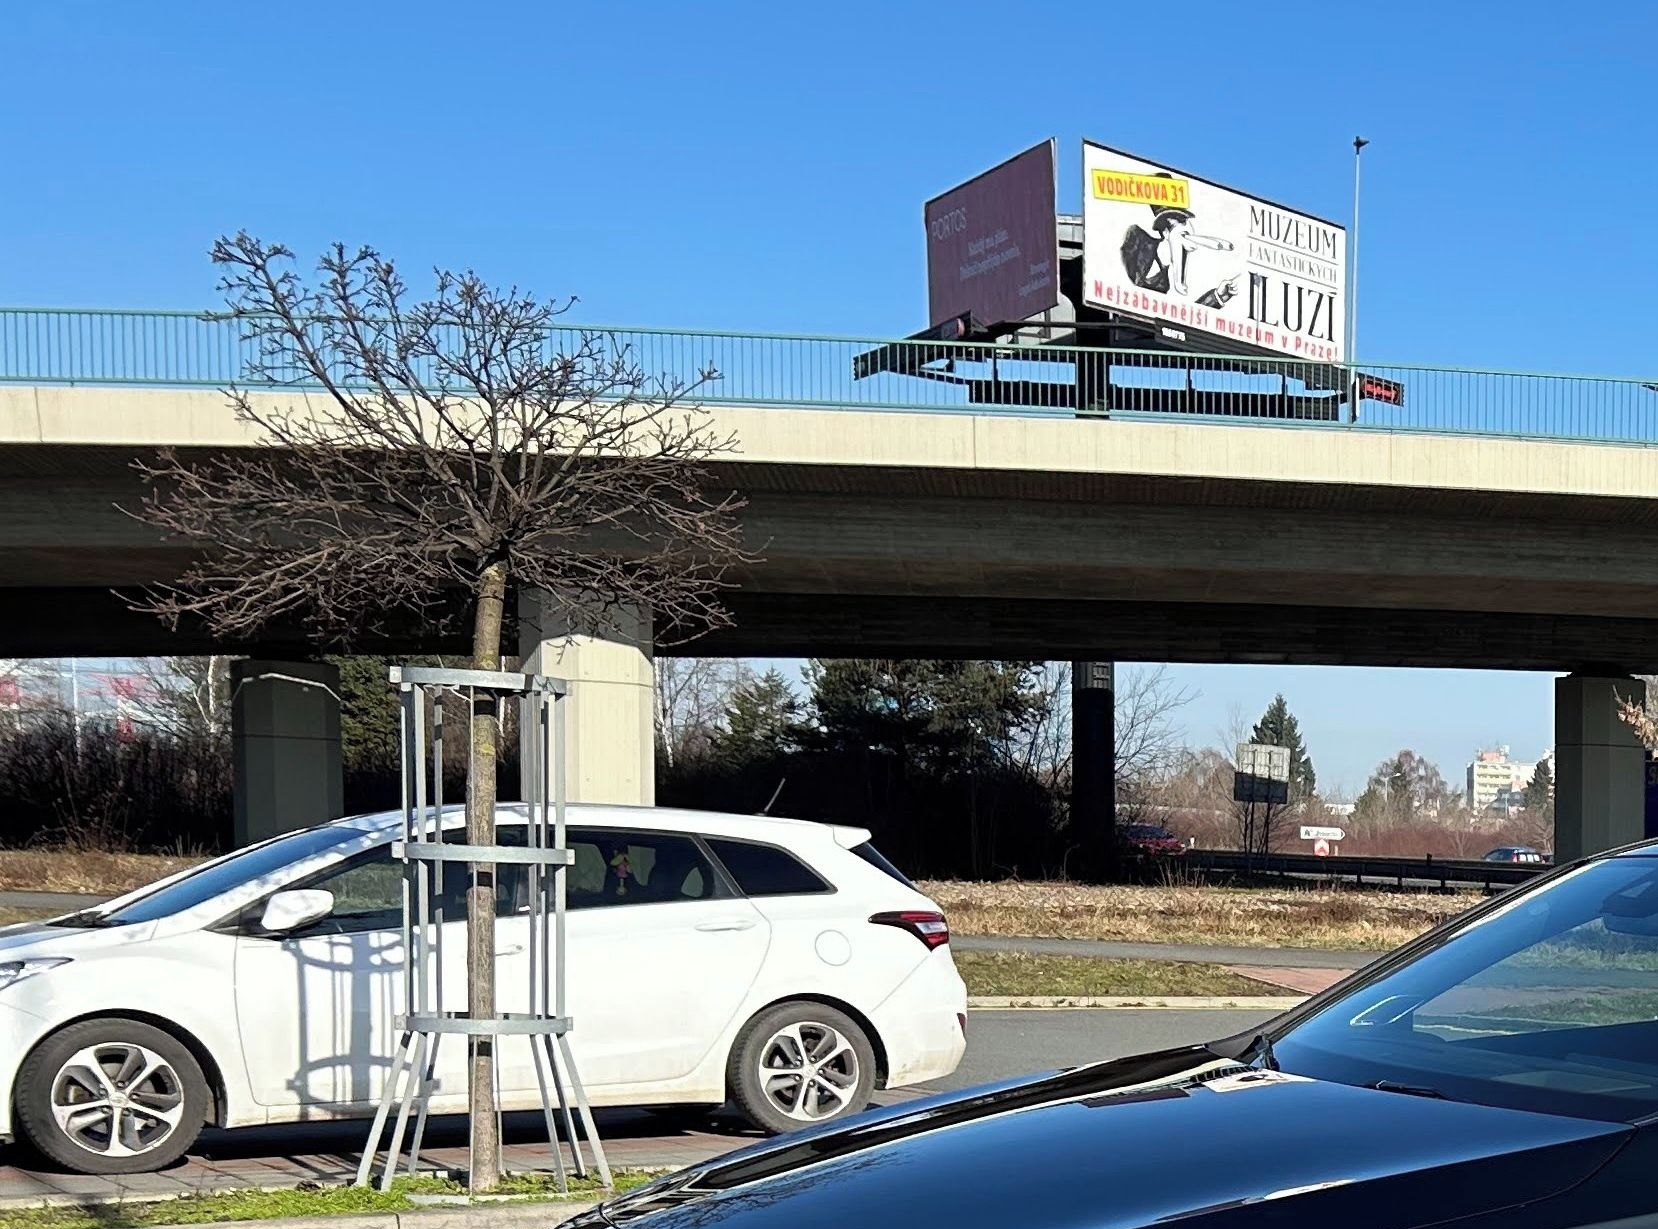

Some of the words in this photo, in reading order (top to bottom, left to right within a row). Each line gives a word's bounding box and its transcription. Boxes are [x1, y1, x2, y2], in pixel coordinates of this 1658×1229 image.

[1097, 176, 1168, 202] VODIČKOVA
[1171, 184, 1185, 204] 31
[1249, 204, 1337, 260] MUZEUM
[1247, 271, 1339, 343] ILUZÍ
[1215, 316, 1274, 345] muzeum
[1281, 335, 1290, 349] v
[1295, 335, 1338, 363] Praze!
